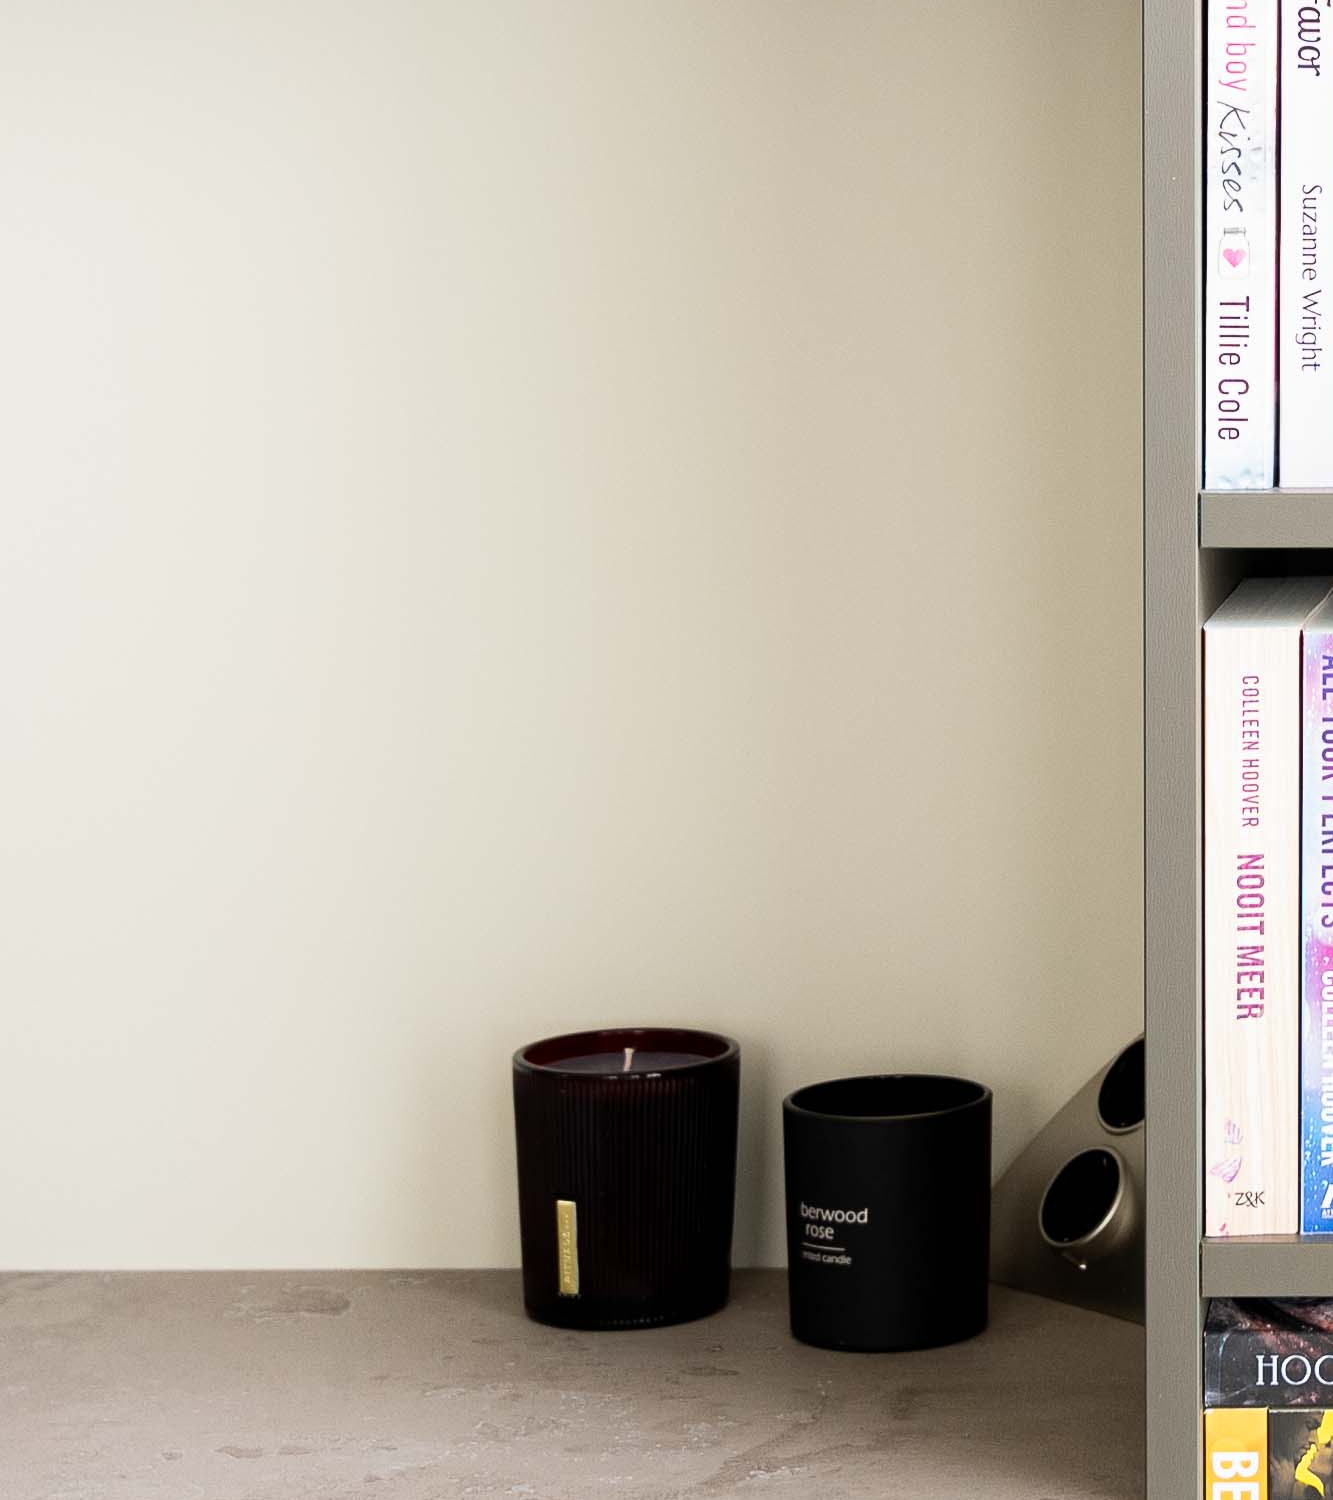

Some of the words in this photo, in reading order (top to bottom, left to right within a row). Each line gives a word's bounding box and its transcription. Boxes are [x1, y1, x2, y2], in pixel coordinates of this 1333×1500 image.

[1300, 184, 1323, 280] Suzanne
[1218, 296, 1249, 366] Tillie
[1297, 289, 1323, 371] Wright
[1217, 379, 1248, 441] Cole
[1236, 854, 1264, 936] NOOIT
[1236, 945, 1264, 1020] MEER
[800, 1202, 868, 1224] berwood
[805, 1224, 834, 1240] rose
[821, 1253, 852, 1265] candle
